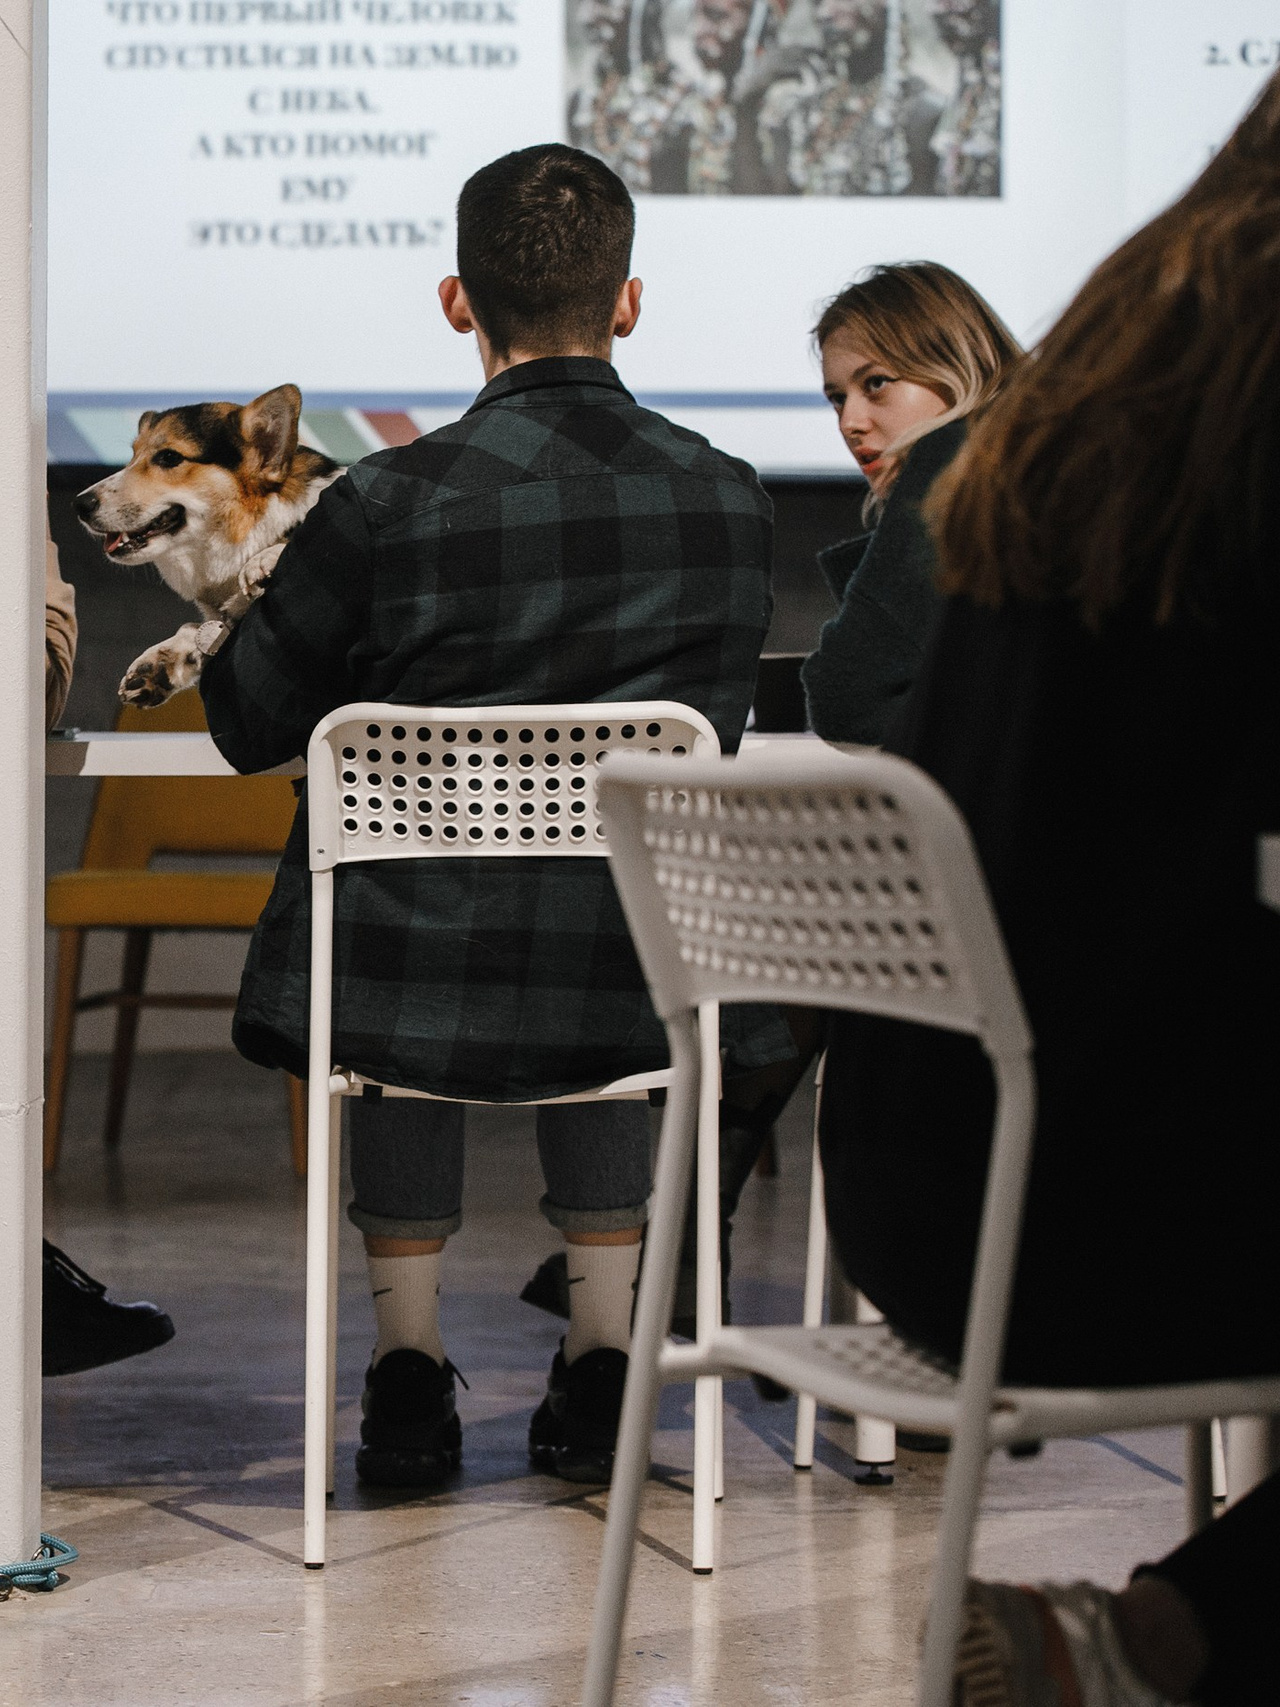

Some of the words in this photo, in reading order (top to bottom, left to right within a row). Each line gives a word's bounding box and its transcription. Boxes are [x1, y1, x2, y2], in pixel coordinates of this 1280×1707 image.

[105, 0, 181, 25] ЧТО
[352, 0, 518, 25] ЧЕЛОВЕК
[104, 43, 321, 69] СПУСТИЛСЯ
[329, 43, 377, 69] НА
[383, 43, 519, 69] ЗЕМЛЮ
[247, 88, 272, 114] С
[190, 133, 215, 158] А
[222, 133, 297, 158] КТО
[304, 133, 436, 158] ПОМОГ
[280, 177, 355, 202] ЕМУ
[190, 219, 263, 246] ЭТО
[268, 219, 445, 248] СДЕЛАТЬ?
